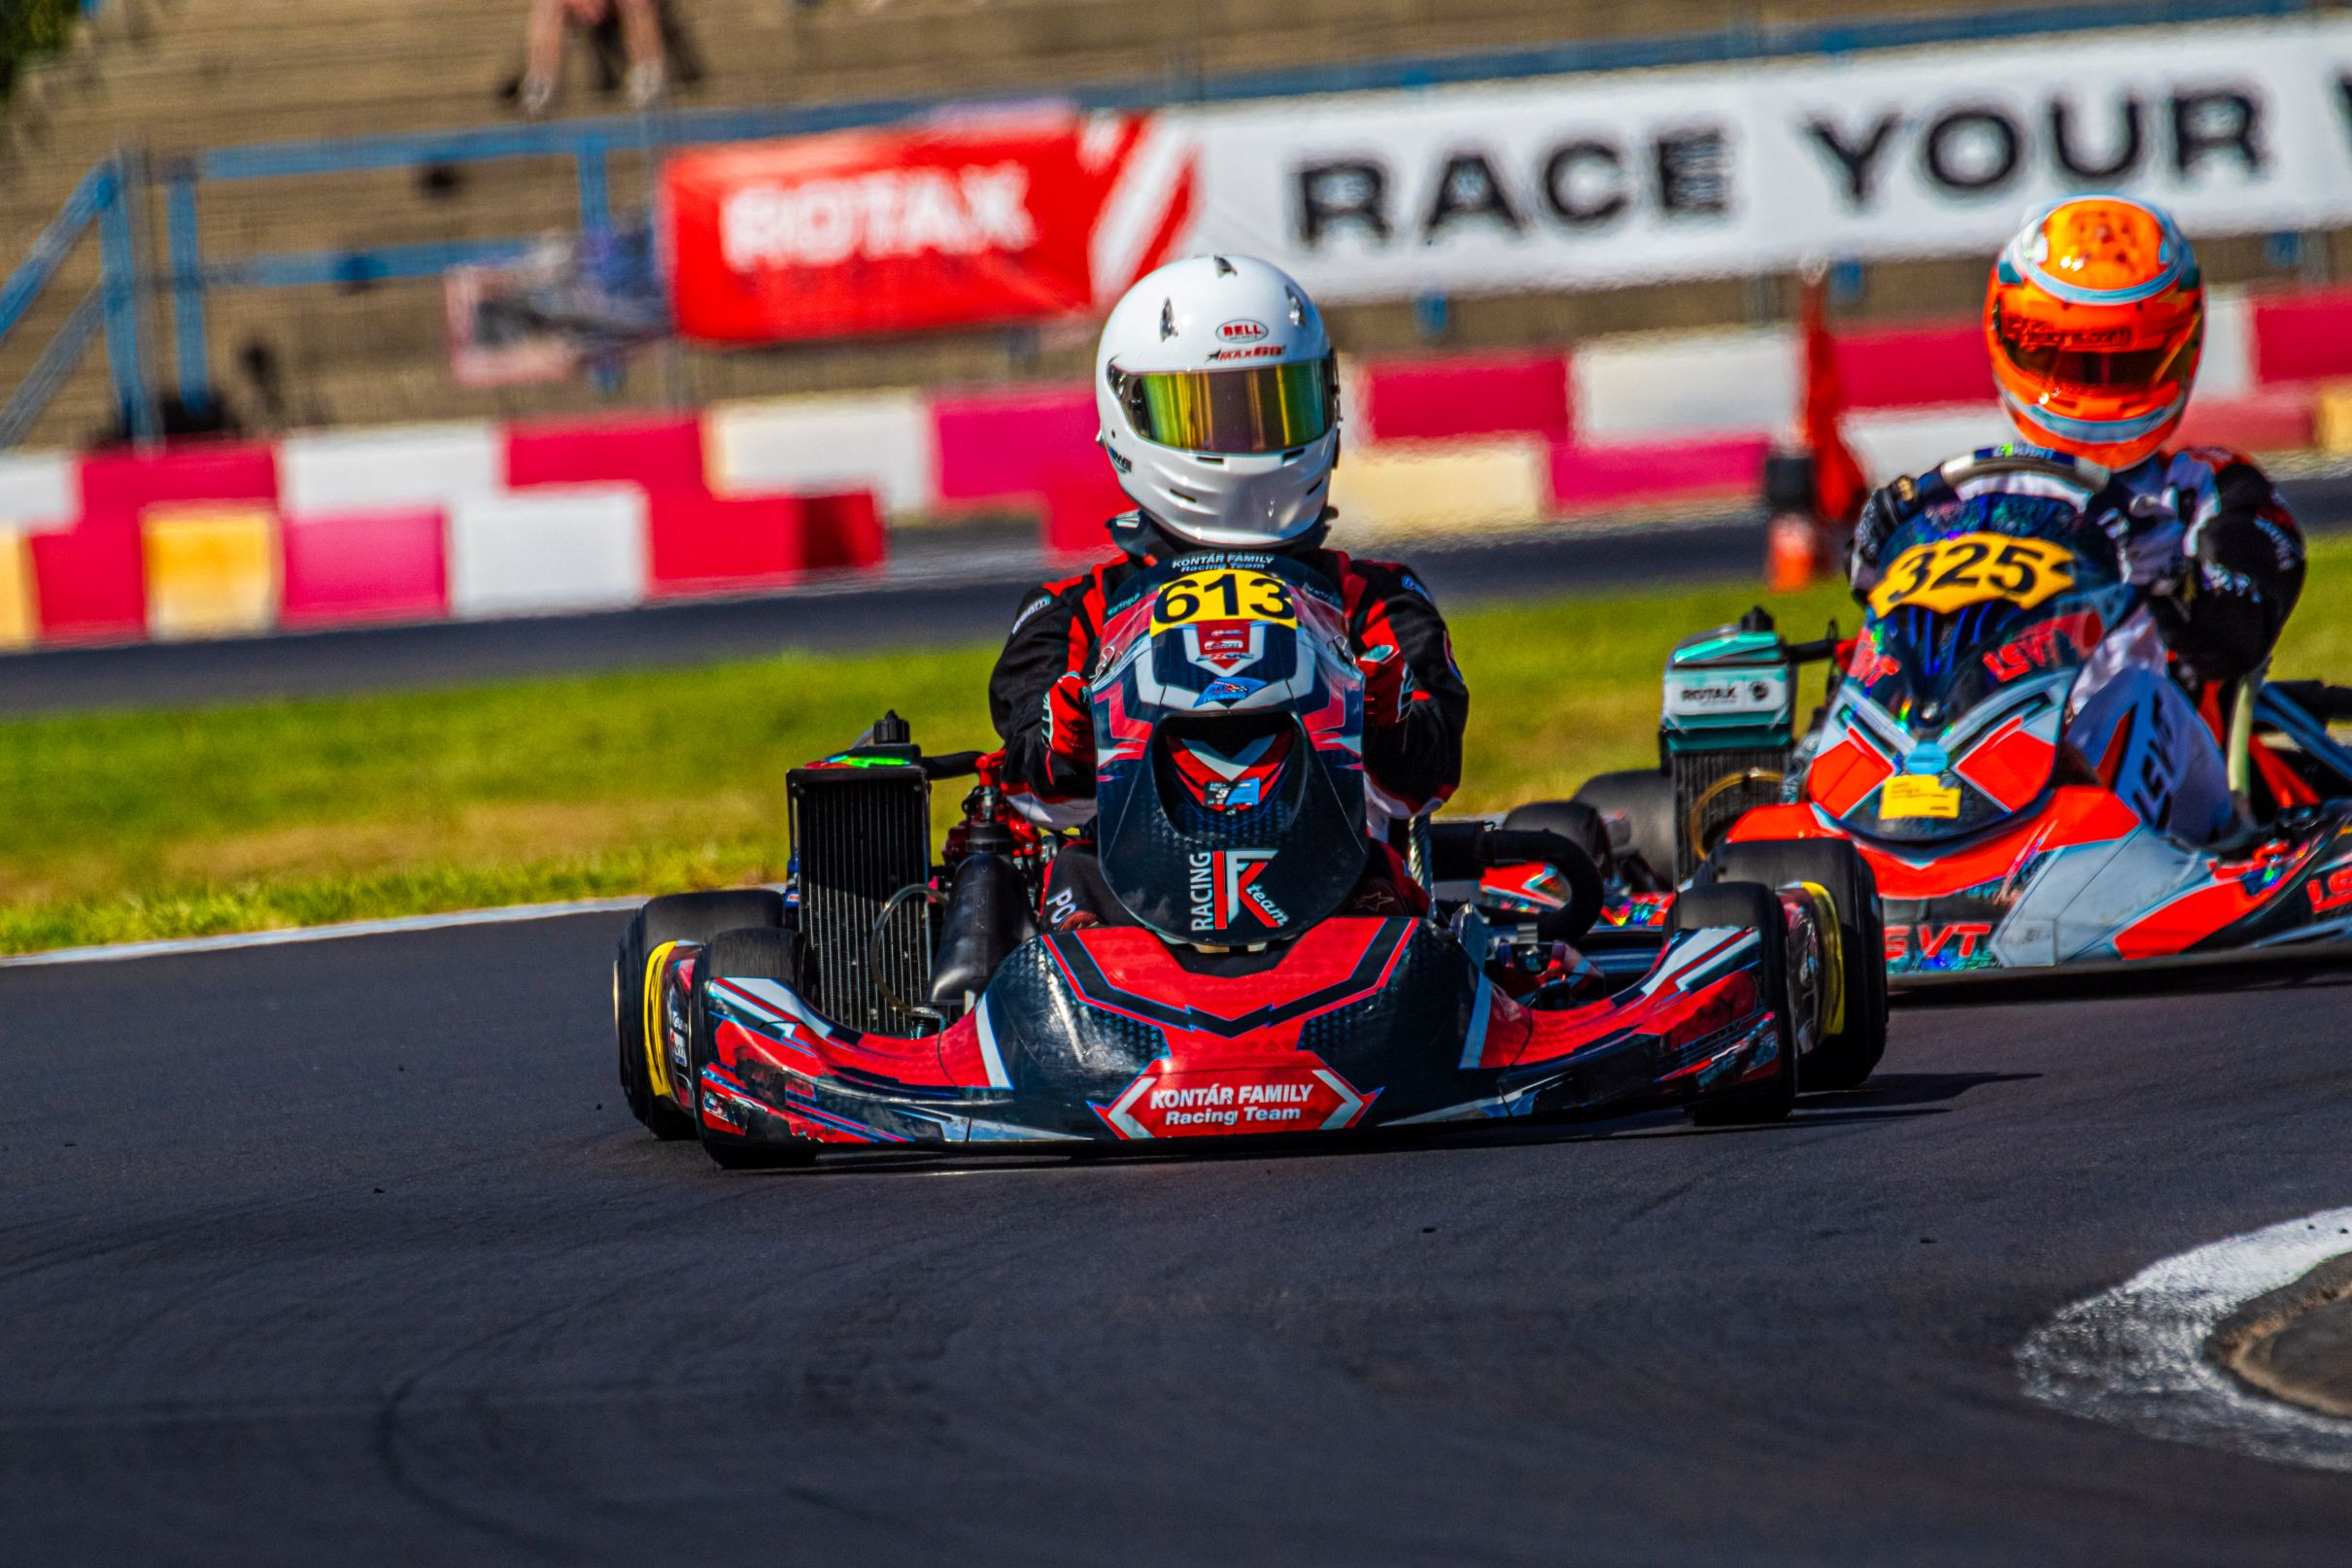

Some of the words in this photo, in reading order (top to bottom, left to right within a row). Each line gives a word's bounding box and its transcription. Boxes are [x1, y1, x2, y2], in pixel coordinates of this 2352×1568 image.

[1294, 122, 1734, 248] RACE
[1804, 85, 2266, 206] YOUR
[720, 159, 1039, 273] ROTAX
[1223, 324, 1261, 336] BELL
[1172, 554, 1224, 568] KONTÁR
[1227, 555, 1275, 564] FAMILY
[1180, 562, 1227, 572] Racing
[1888, 542, 2044, 603] 325
[1153, 573, 1296, 625] 613
[1189, 852, 1213, 931] RACING
[1245, 884, 1290, 926] team
[1150, 1083, 1234, 1109] KONTÁR
[1238, 1084, 1313, 1105] FAMILY
[1166, 1110, 1238, 1125] Racing
[1244, 1107, 1301, 1121] Team
